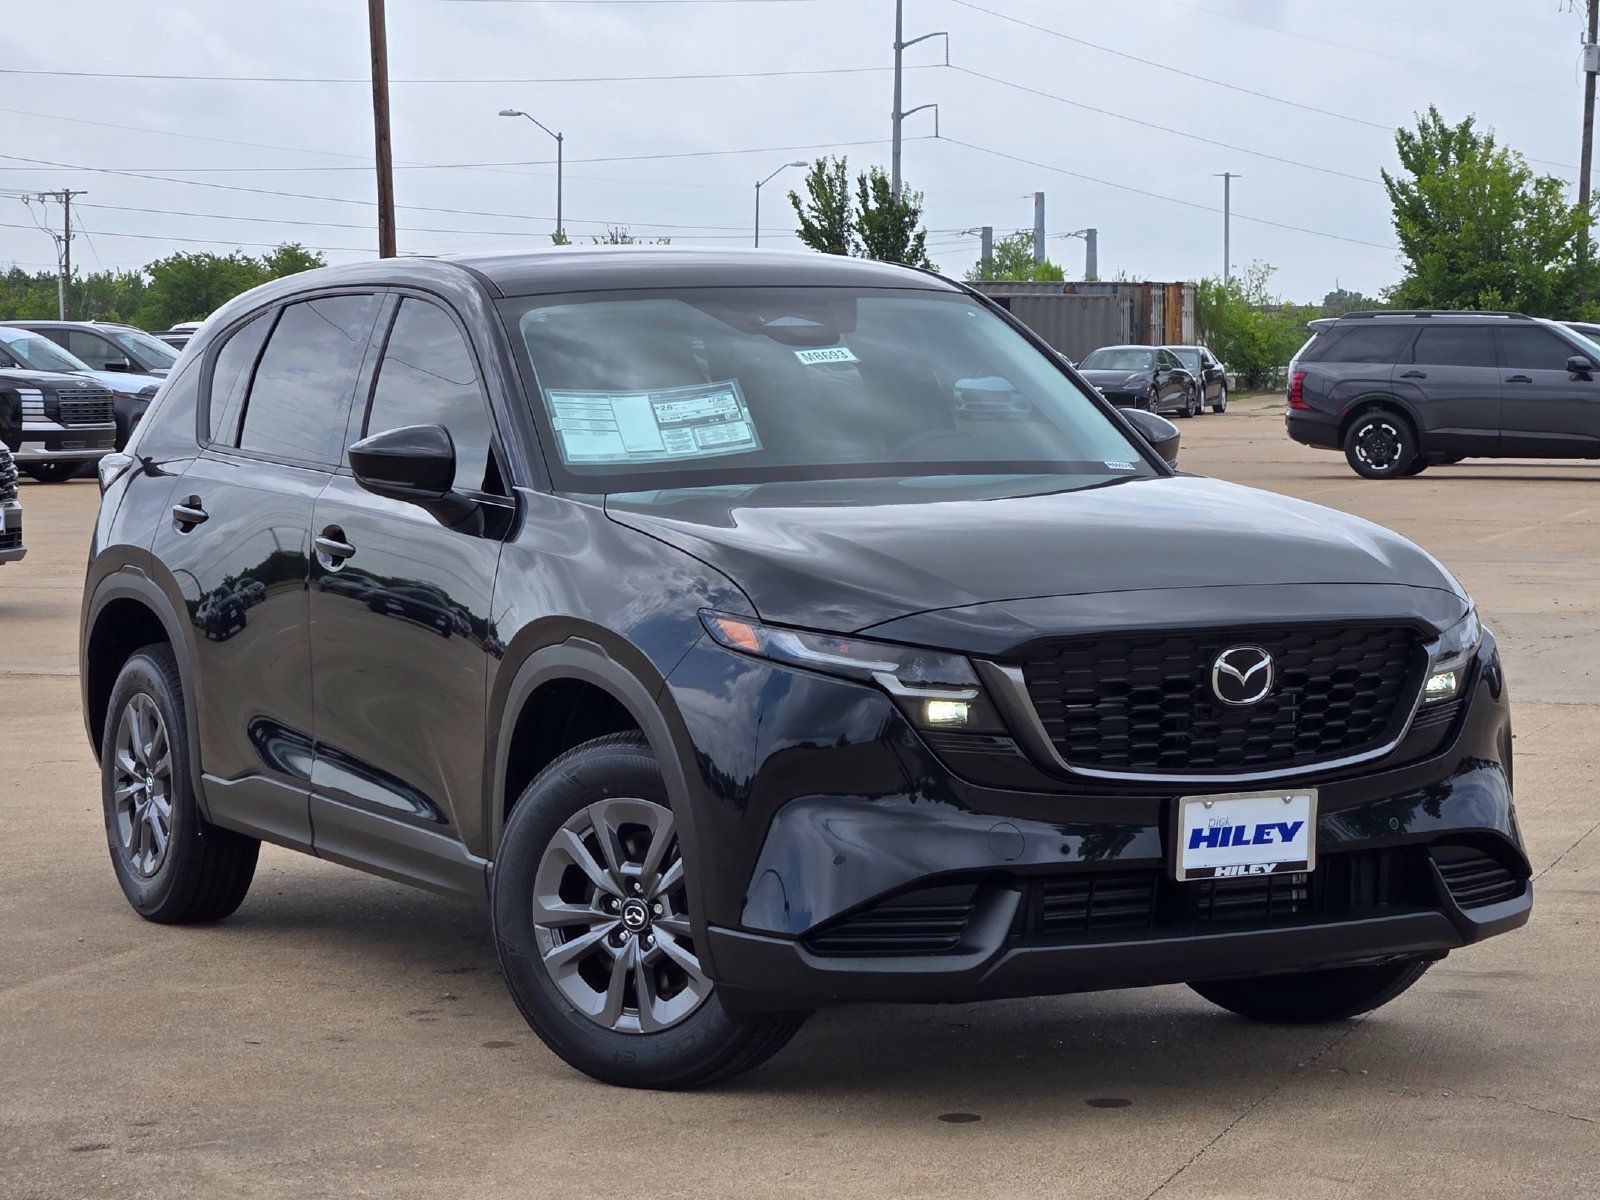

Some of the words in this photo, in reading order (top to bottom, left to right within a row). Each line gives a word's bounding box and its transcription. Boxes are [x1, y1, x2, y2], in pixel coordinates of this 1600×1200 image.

[800, 349, 848, 362] M8693
[1208, 815, 1232, 828] pick
[1188, 821, 1304, 849] HILEY
[1214, 863, 1277, 877] HILEY
